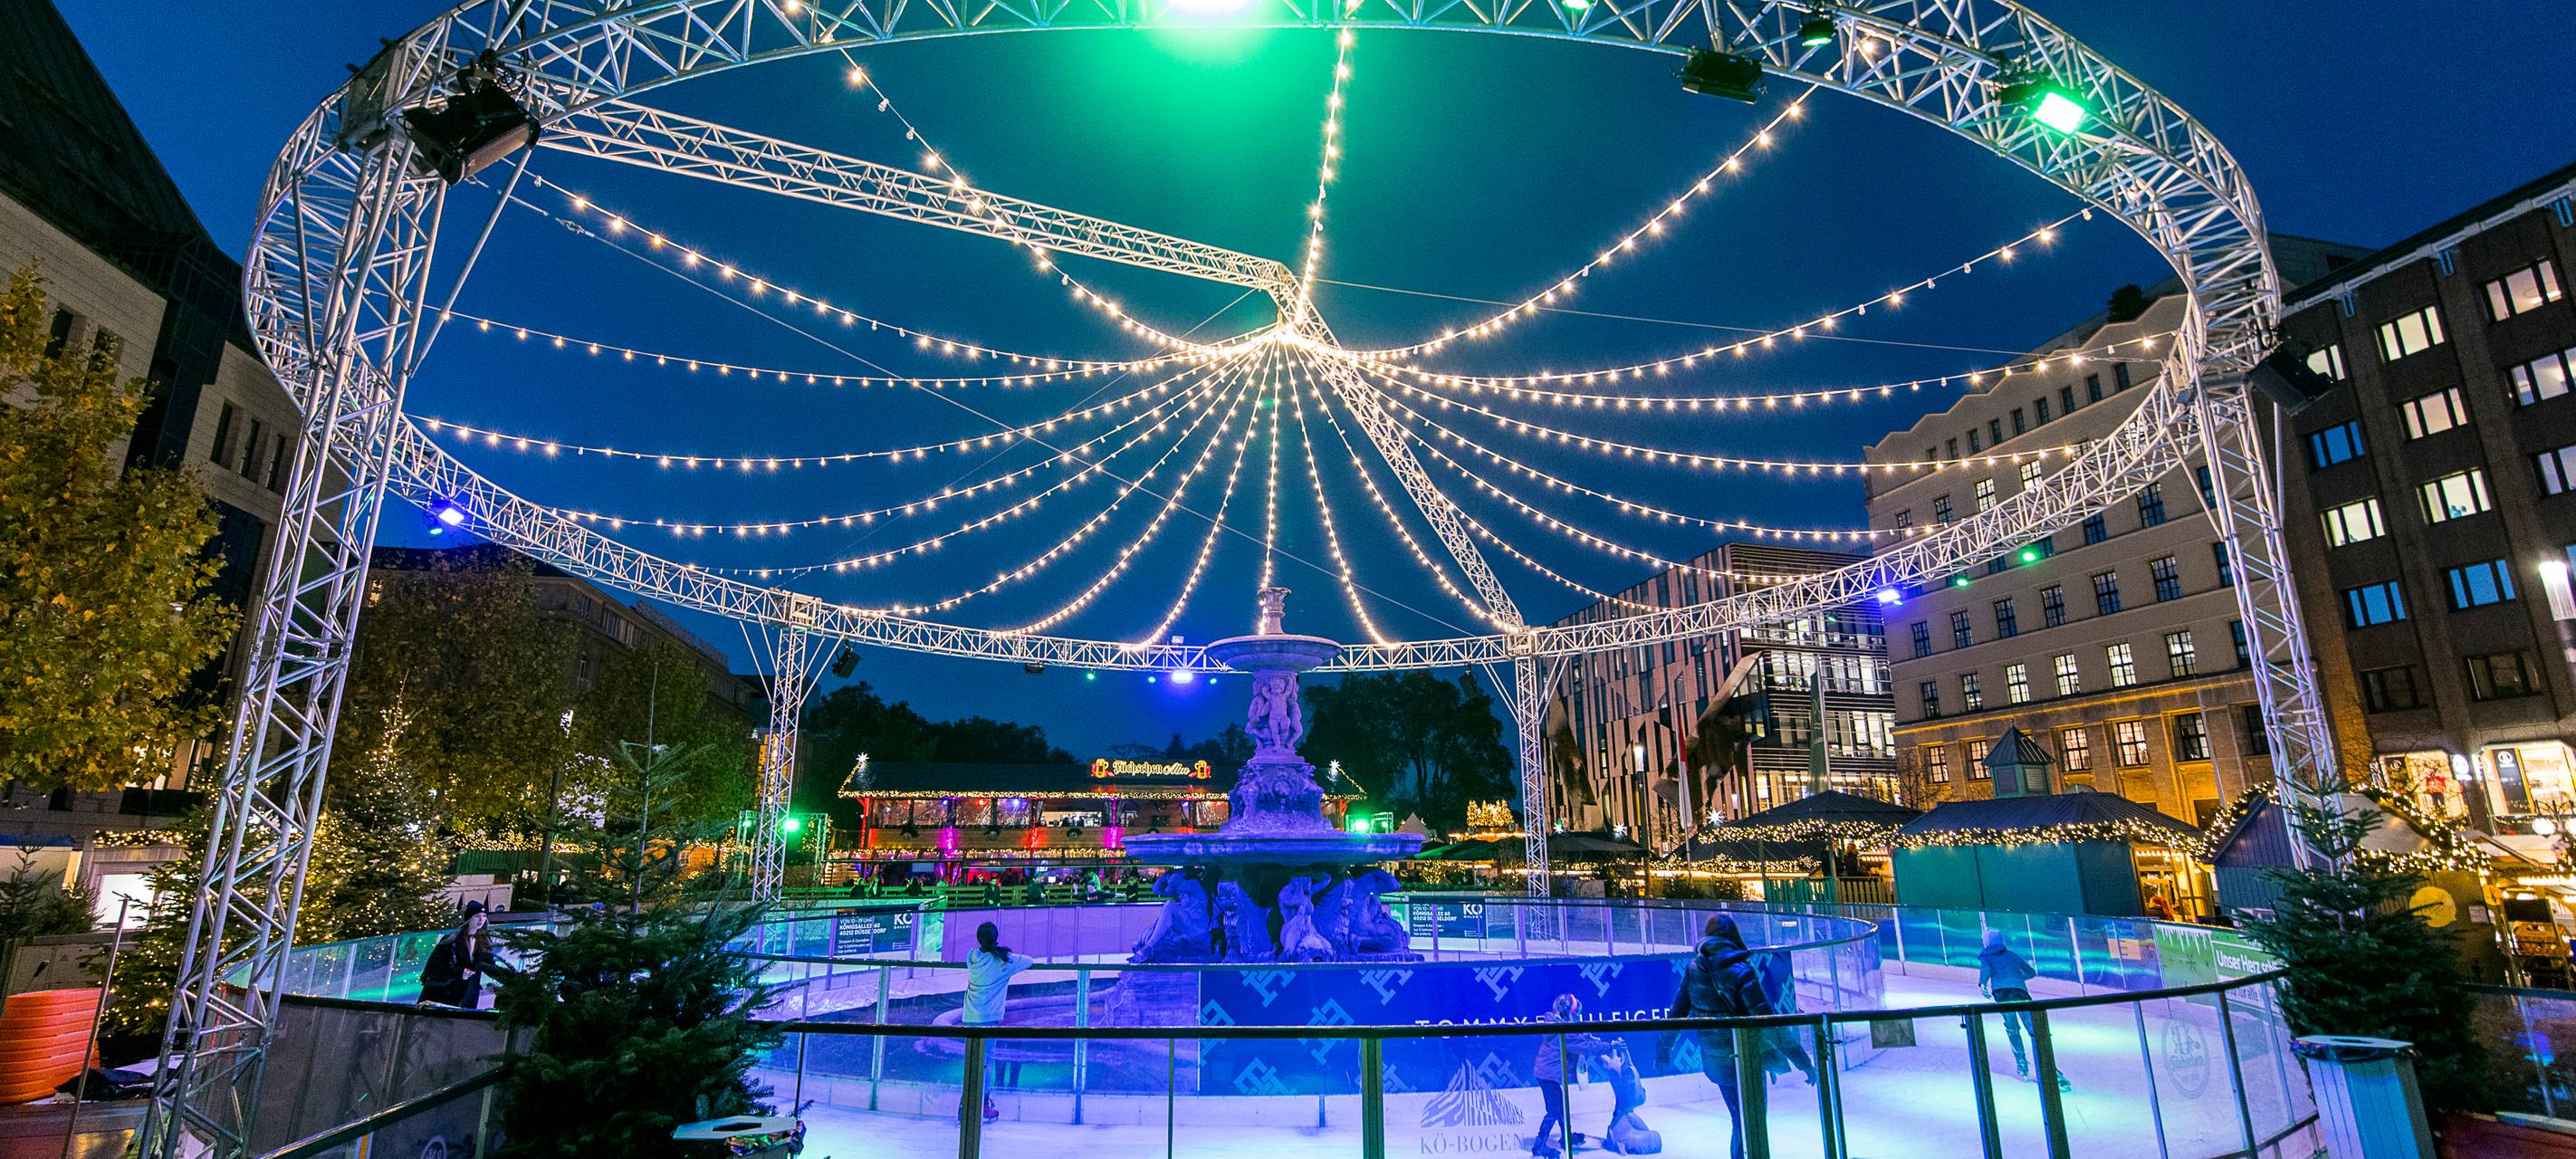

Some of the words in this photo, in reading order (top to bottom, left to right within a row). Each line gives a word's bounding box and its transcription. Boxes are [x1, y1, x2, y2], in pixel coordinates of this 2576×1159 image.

[2216, 950, 2241, 971] Unser
[2240, 953, 2261, 974] Herz
[1420, 1132, 1525, 1154] KÖ-BOGEN
